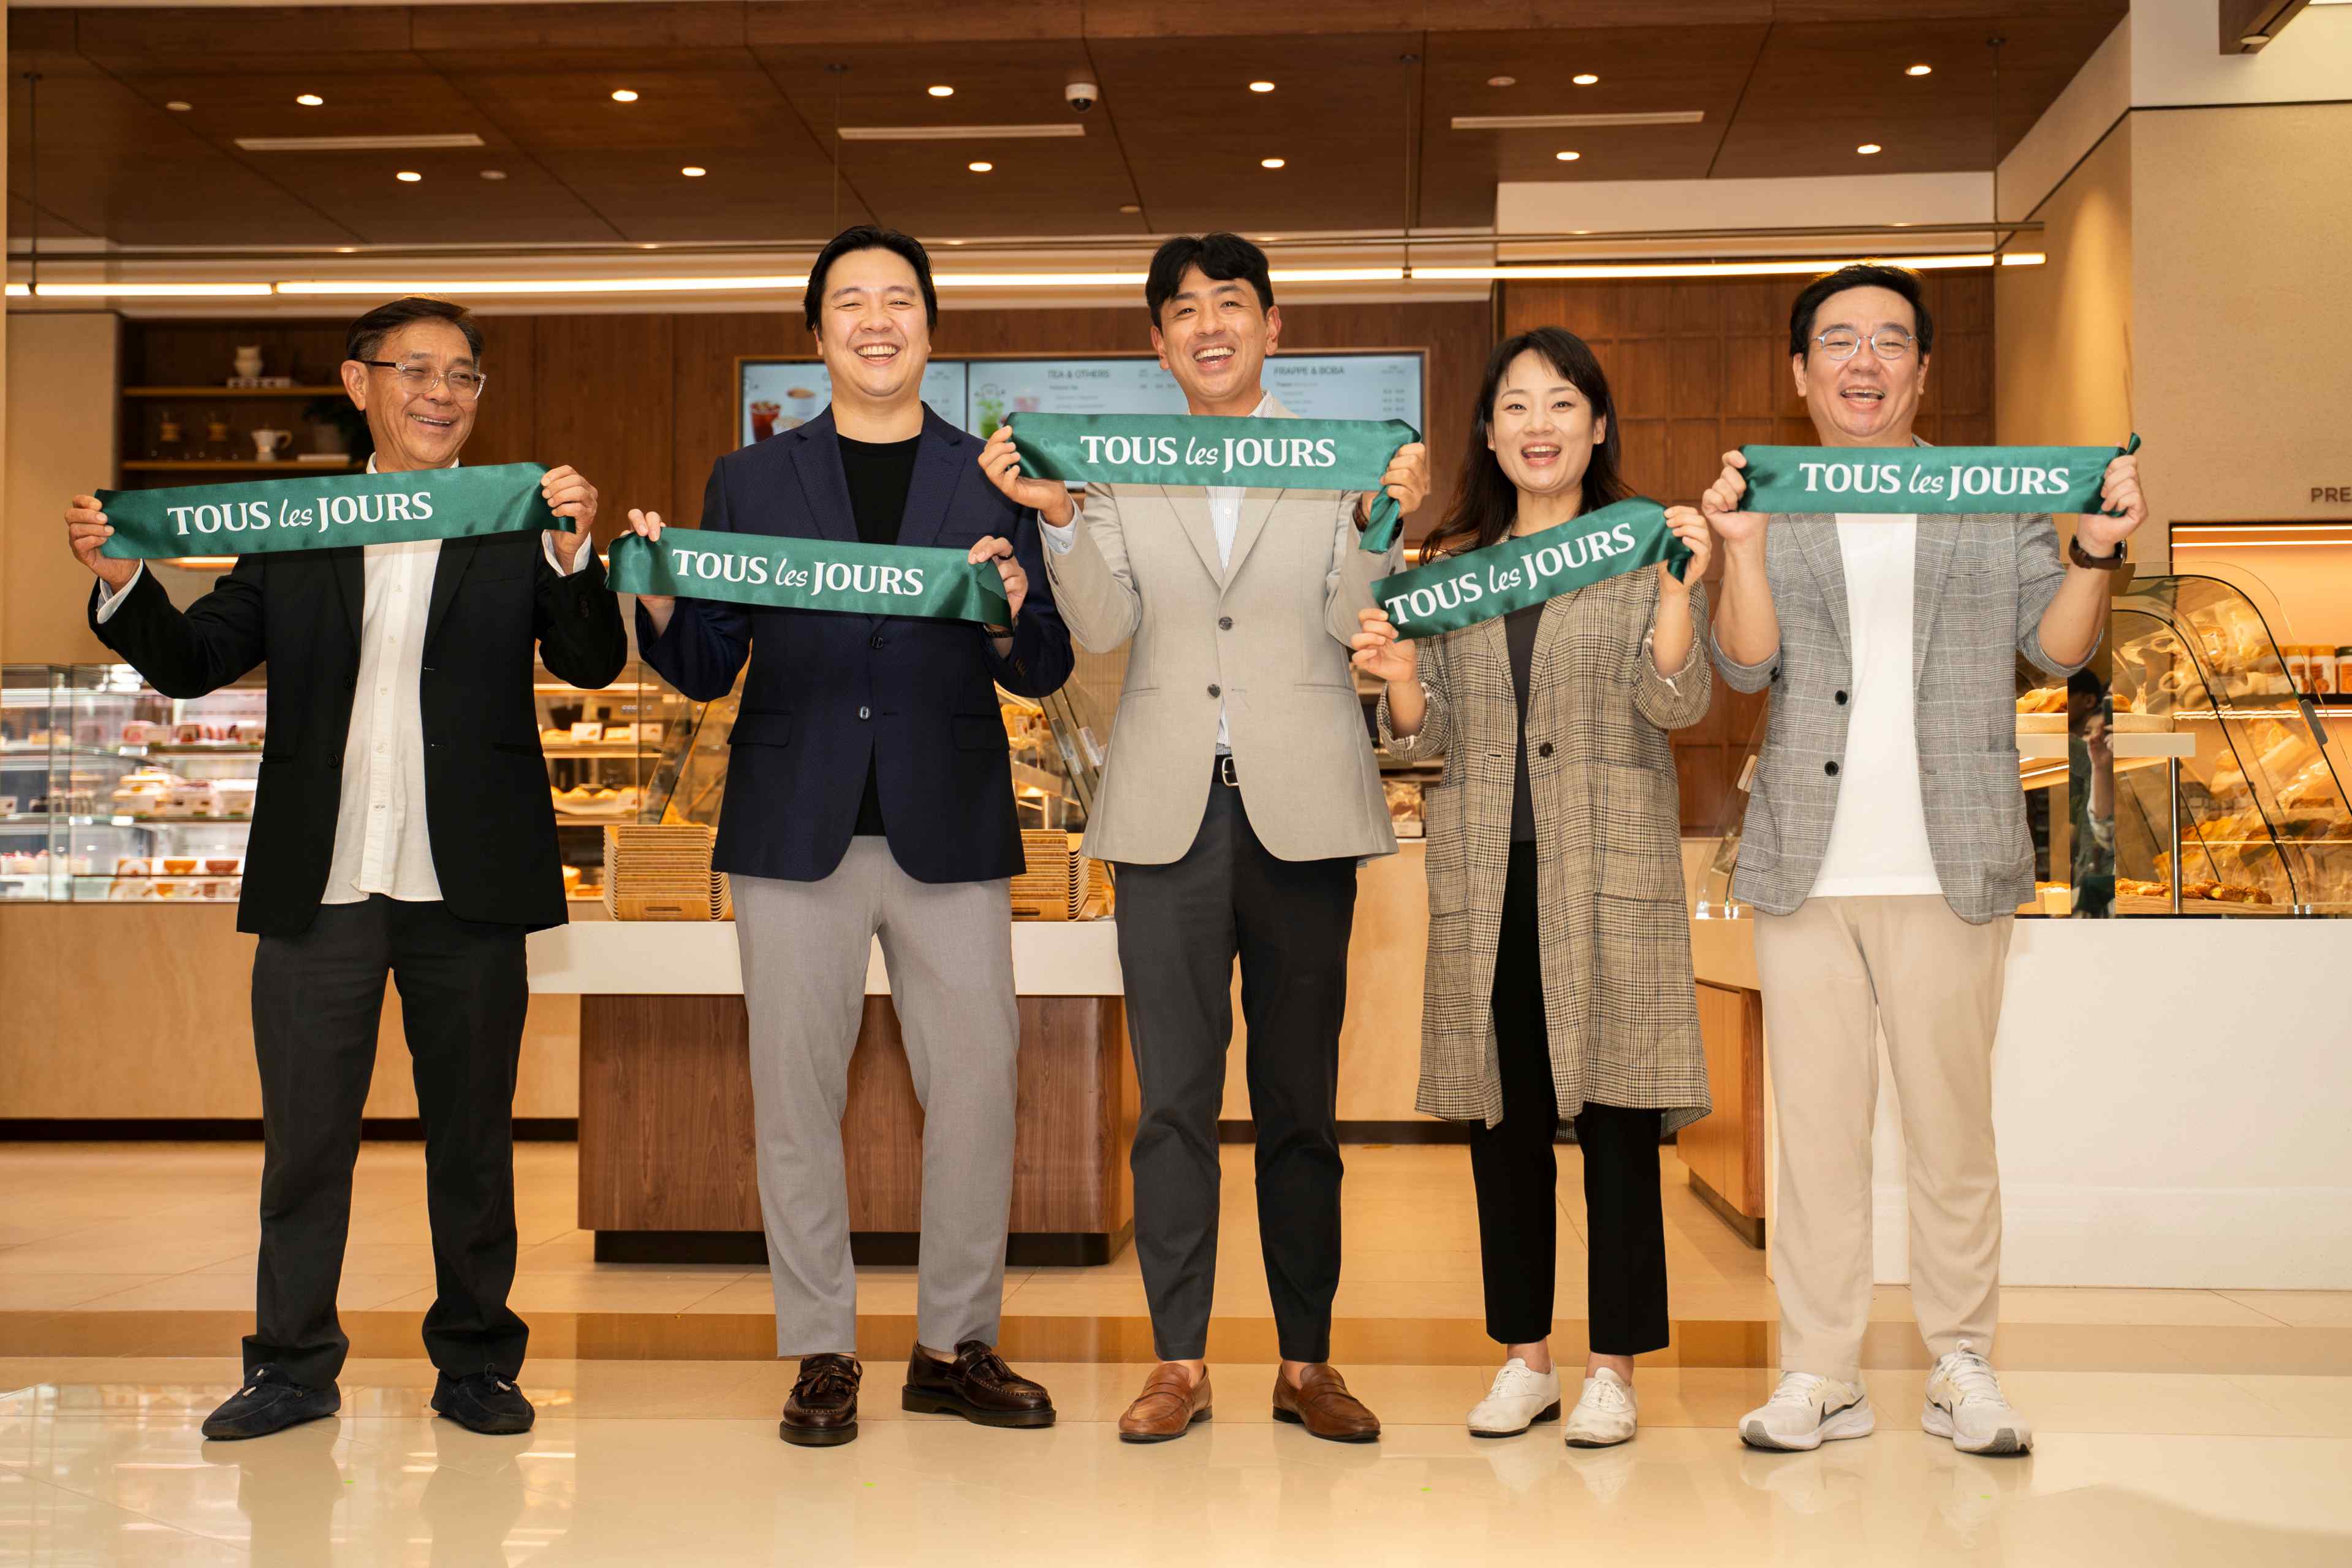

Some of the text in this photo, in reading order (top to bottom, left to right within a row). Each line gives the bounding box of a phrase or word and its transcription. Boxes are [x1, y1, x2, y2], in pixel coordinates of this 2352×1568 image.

[1048, 369, 1064, 378] TEA
[1080, 435, 1337, 474] TOUS les JOURS
[1799, 463, 2069, 501] TOUS les JOURS
[167, 491, 433, 535] TOUS les JOURS
[672, 548, 924, 596] TOUS les JOURS
[1384, 522, 1636, 624] TOUS les JOURS
